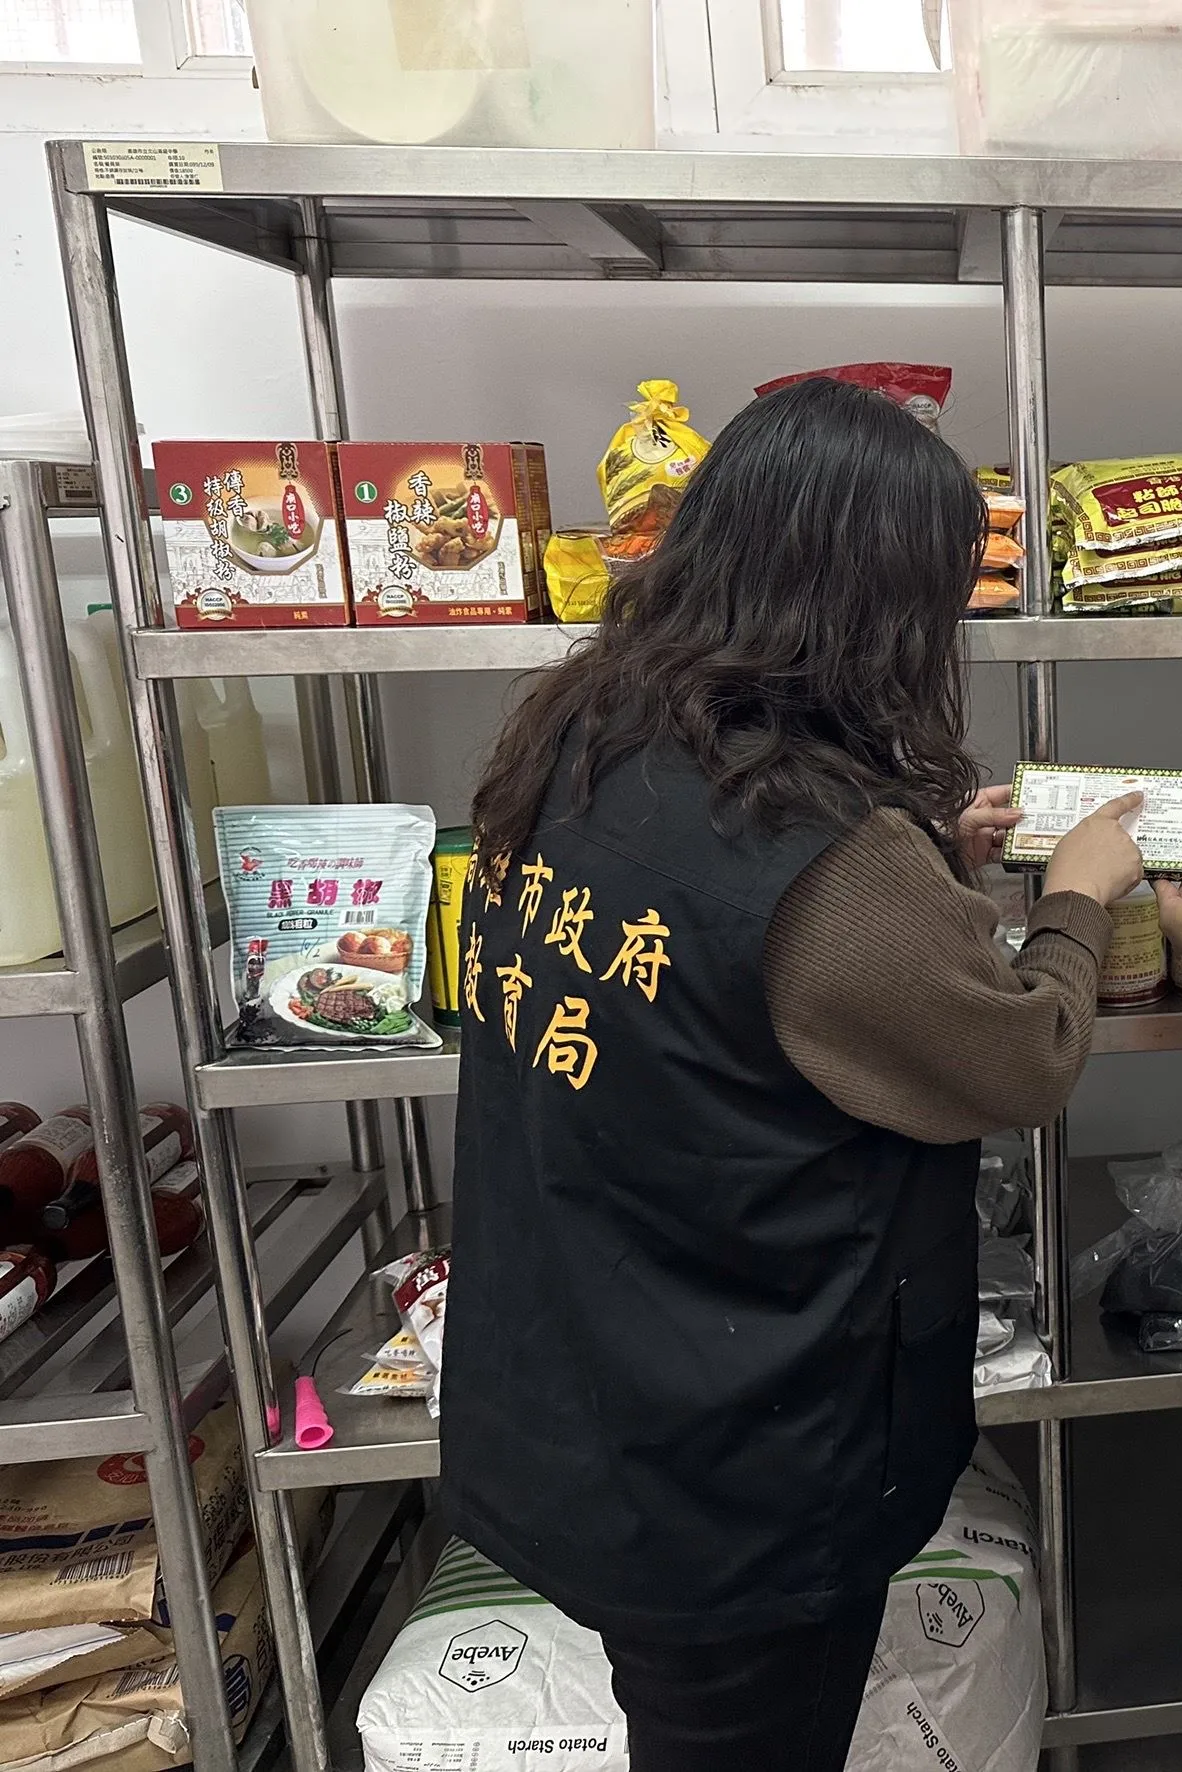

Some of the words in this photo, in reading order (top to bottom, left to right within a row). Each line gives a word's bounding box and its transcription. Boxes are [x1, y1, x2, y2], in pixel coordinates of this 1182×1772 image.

[175, 485, 188, 504] 3
[223, 468, 248, 518] 傳香
[360, 483, 371, 501] 1
[407, 469, 438, 526] 香辣
[203, 475, 237, 582] 特級胡椒粉
[383, 499, 417, 580] 椒鹽粉
[266, 878, 384, 910] 黑胡椒
[463, 921, 599, 1091] 教育局
[963, 1526, 1034, 1556] tarch
[450, 1645, 520, 1665] Avebe
[906, 1701, 939, 1749] Starch
[507, 1739, 555, 1754] Starch
[558, 1737, 608, 1752] Potato
